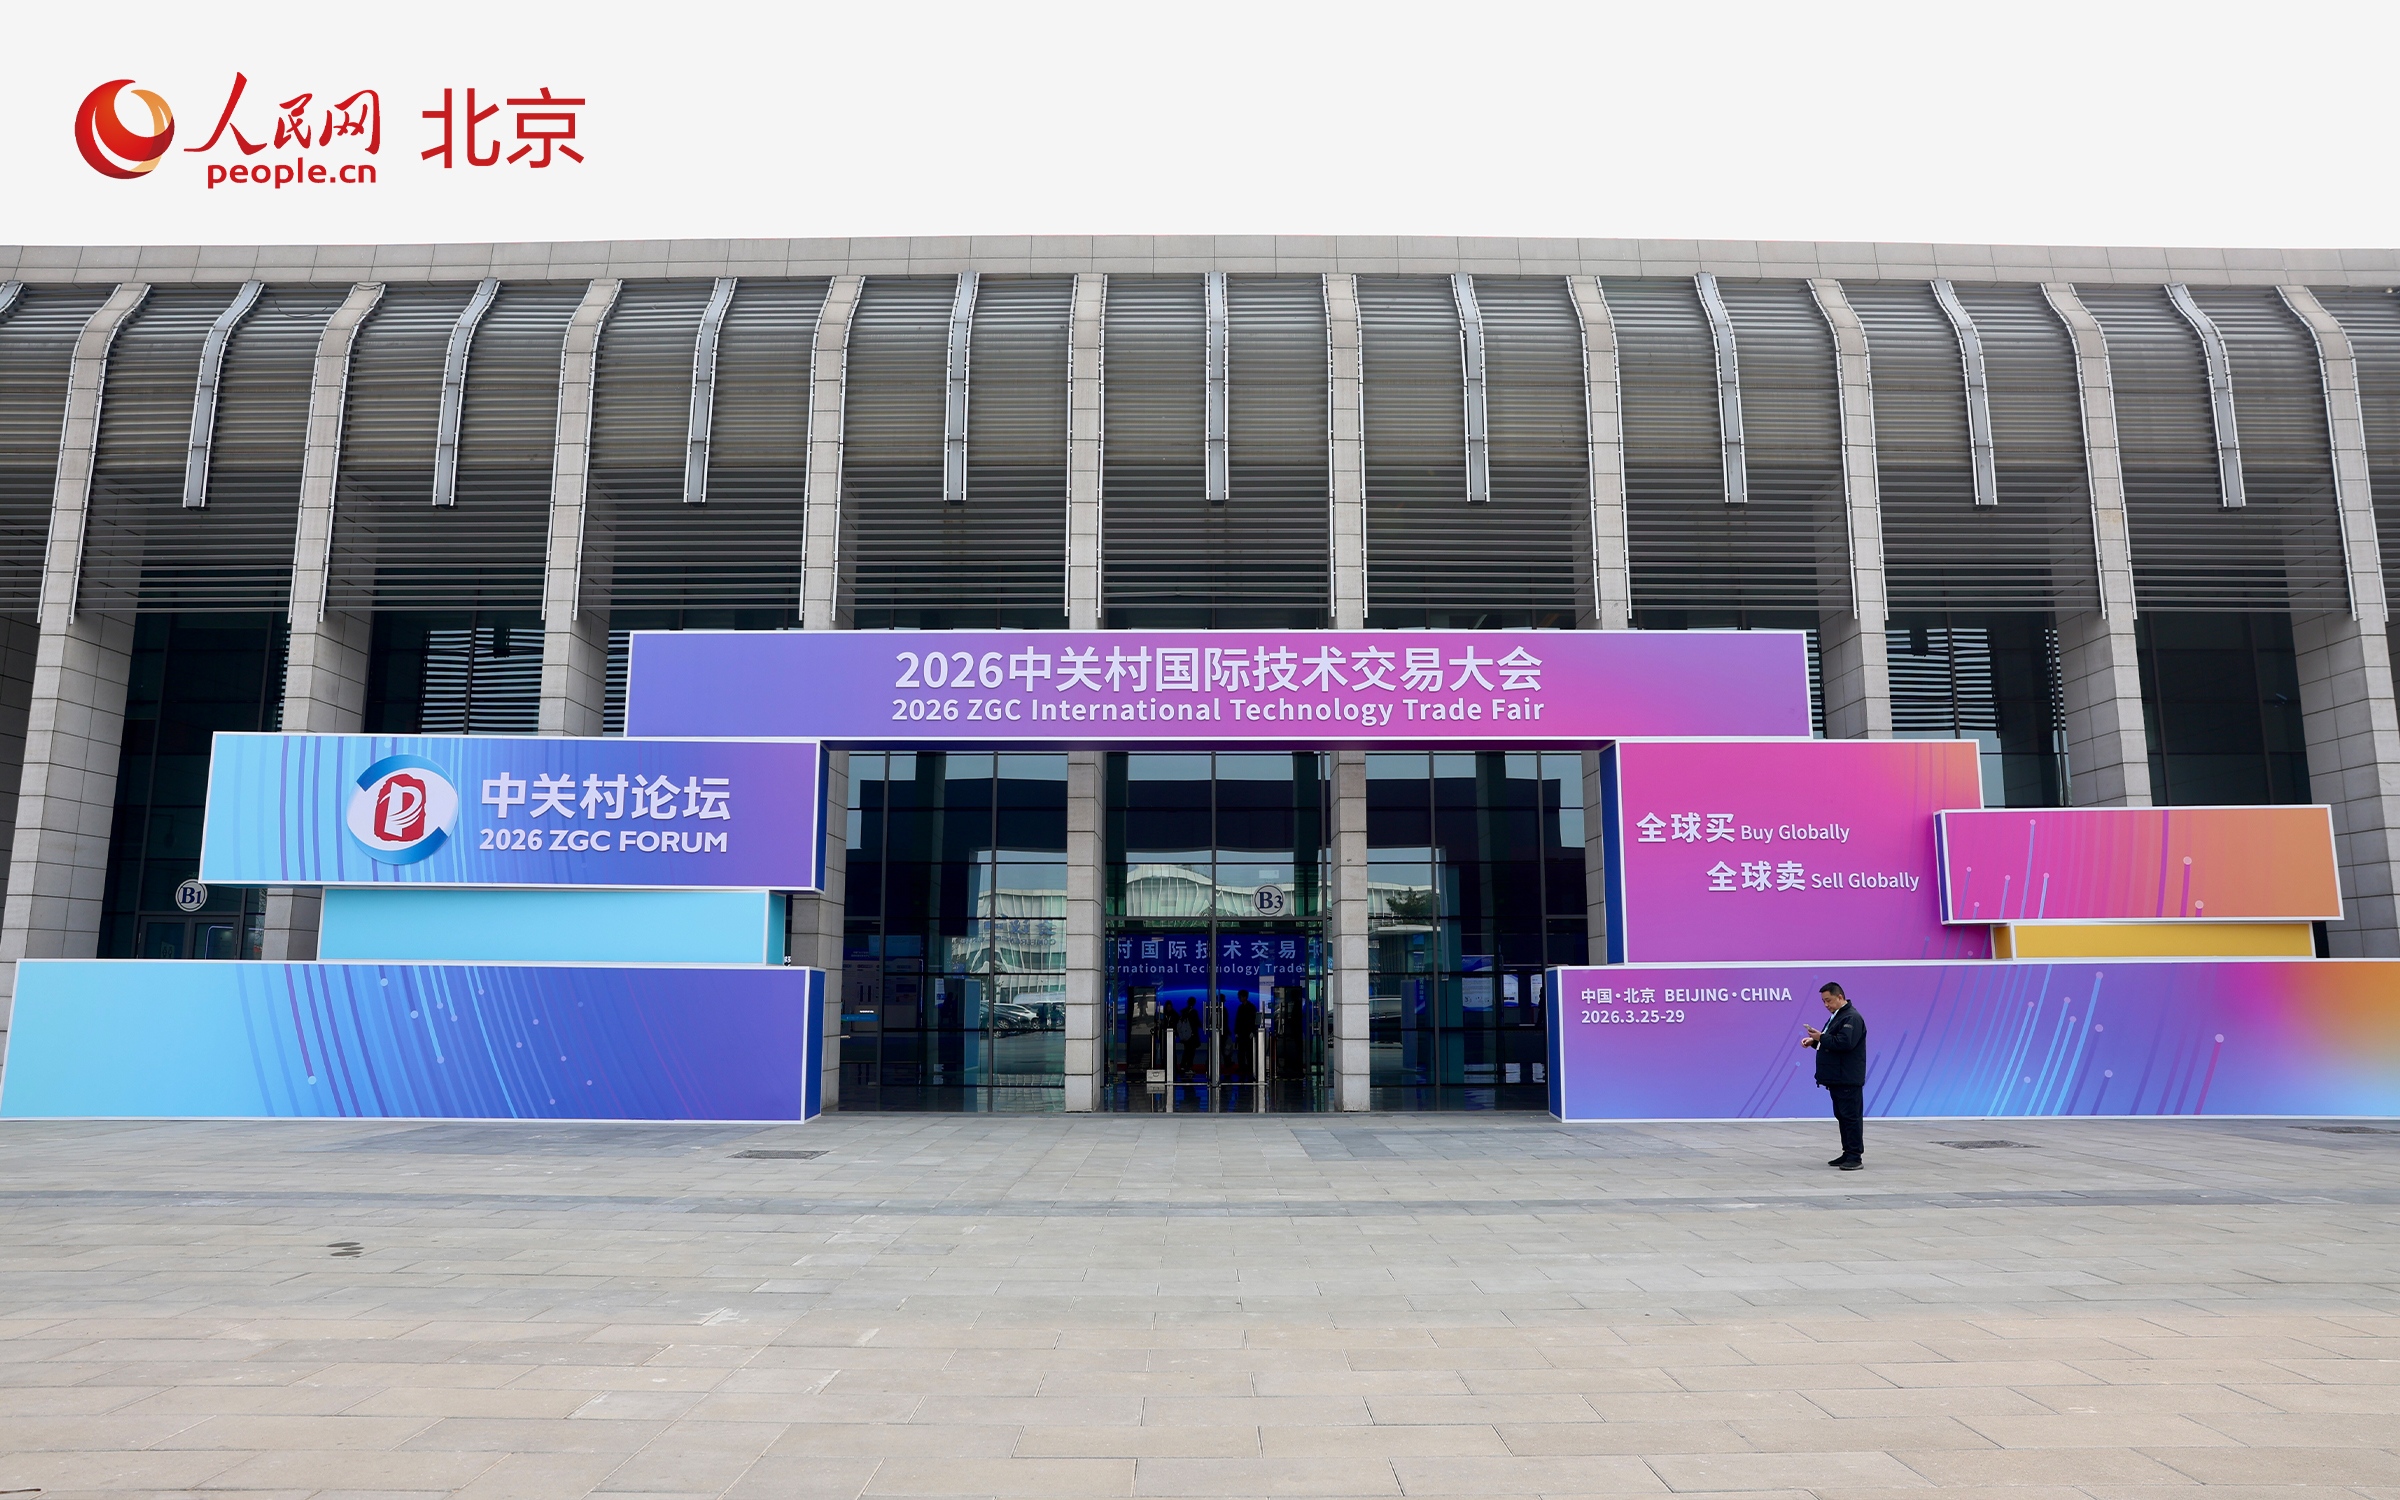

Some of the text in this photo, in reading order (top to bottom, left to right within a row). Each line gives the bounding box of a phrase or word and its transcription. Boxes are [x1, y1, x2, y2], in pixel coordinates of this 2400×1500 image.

[895, 646, 1542, 692] 2026中关村国际技术交易大会
[892, 697, 1544, 726] 2026 ZGC International Technology Trade Fair
[481, 772, 731, 820] 中关村论坛
[479, 828, 728, 853] 2026 ZGC FORUM
[1636, 812, 1850, 843] 全球买 Buy Globally
[1706, 860, 1919, 891] 全球卖 Sell Globally
[181, 886, 202, 905] B1
[1259, 891, 1284, 909] B3
[1265, 963, 1303, 974] Trade
[1581, 1009, 1685, 1024] 2026.3.25-29
